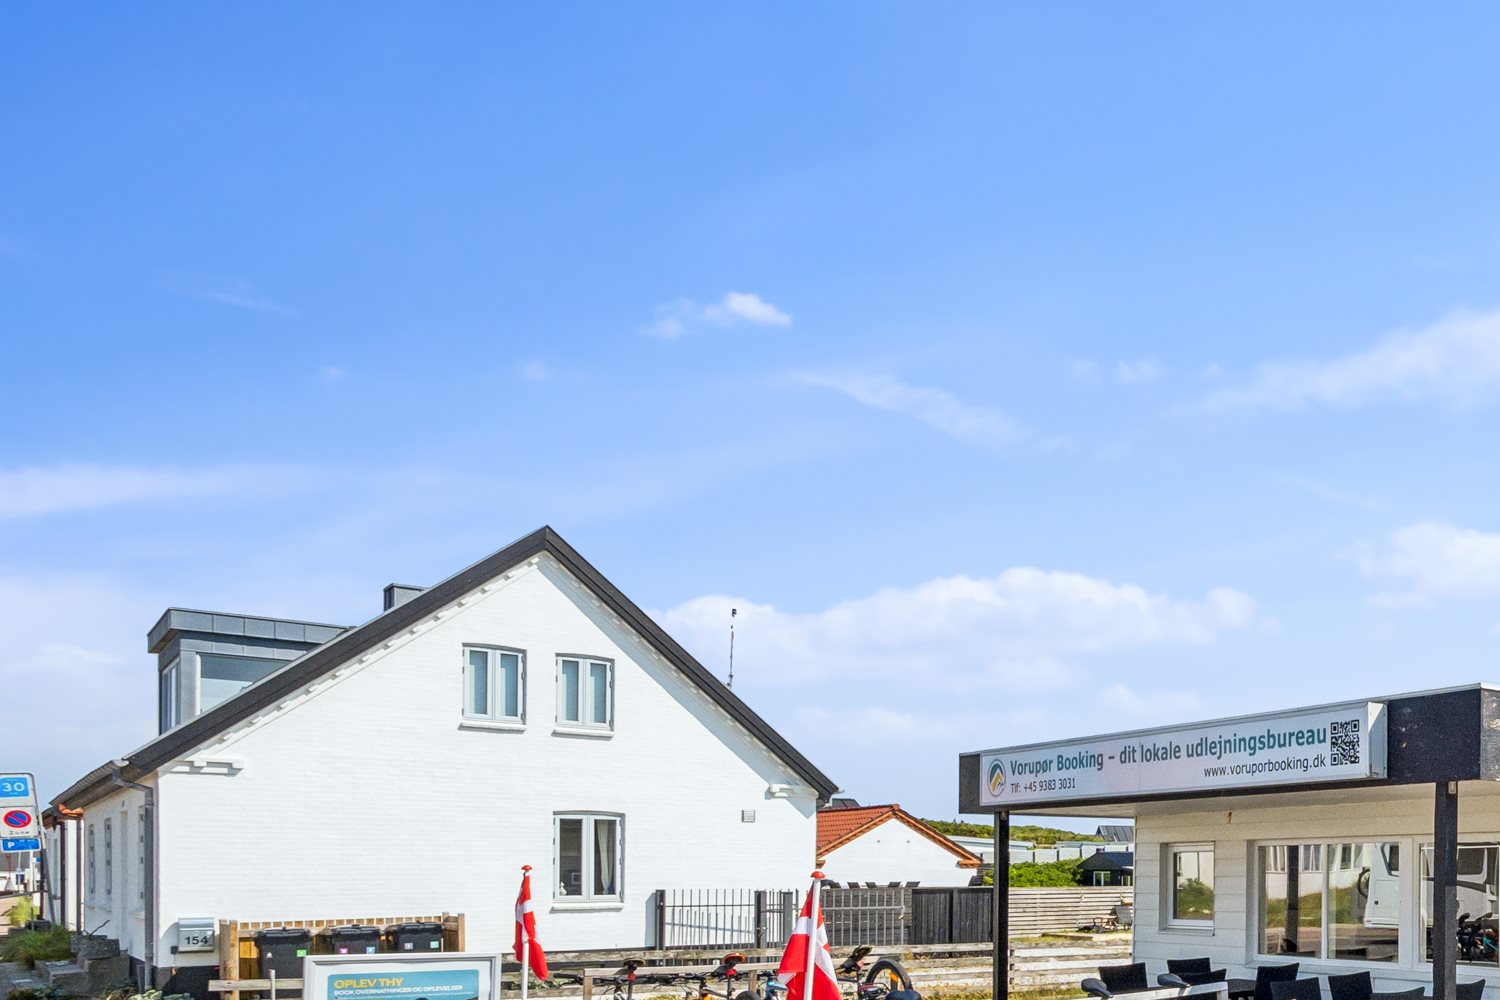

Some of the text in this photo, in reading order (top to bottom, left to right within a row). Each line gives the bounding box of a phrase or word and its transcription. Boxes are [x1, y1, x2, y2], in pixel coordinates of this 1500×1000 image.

[1010, 759, 1053, 777] Vorupør
[1056, 751, 1104, 771] Booking
[1119, 745, 1137, 764] dit
[1140, 741, 1181, 763] lokale
[1186, 727, 1327, 760] udlejningsbureau
[1203, 754, 1327, 777] www.voruporbooking.dk
[2, 782, 25, 792] 30
[1010, 777, 1076, 794] Tlf: +45 9383 3031
[184, 935, 209, 945] 154
[334, 977, 404, 989] OPLEV THY
